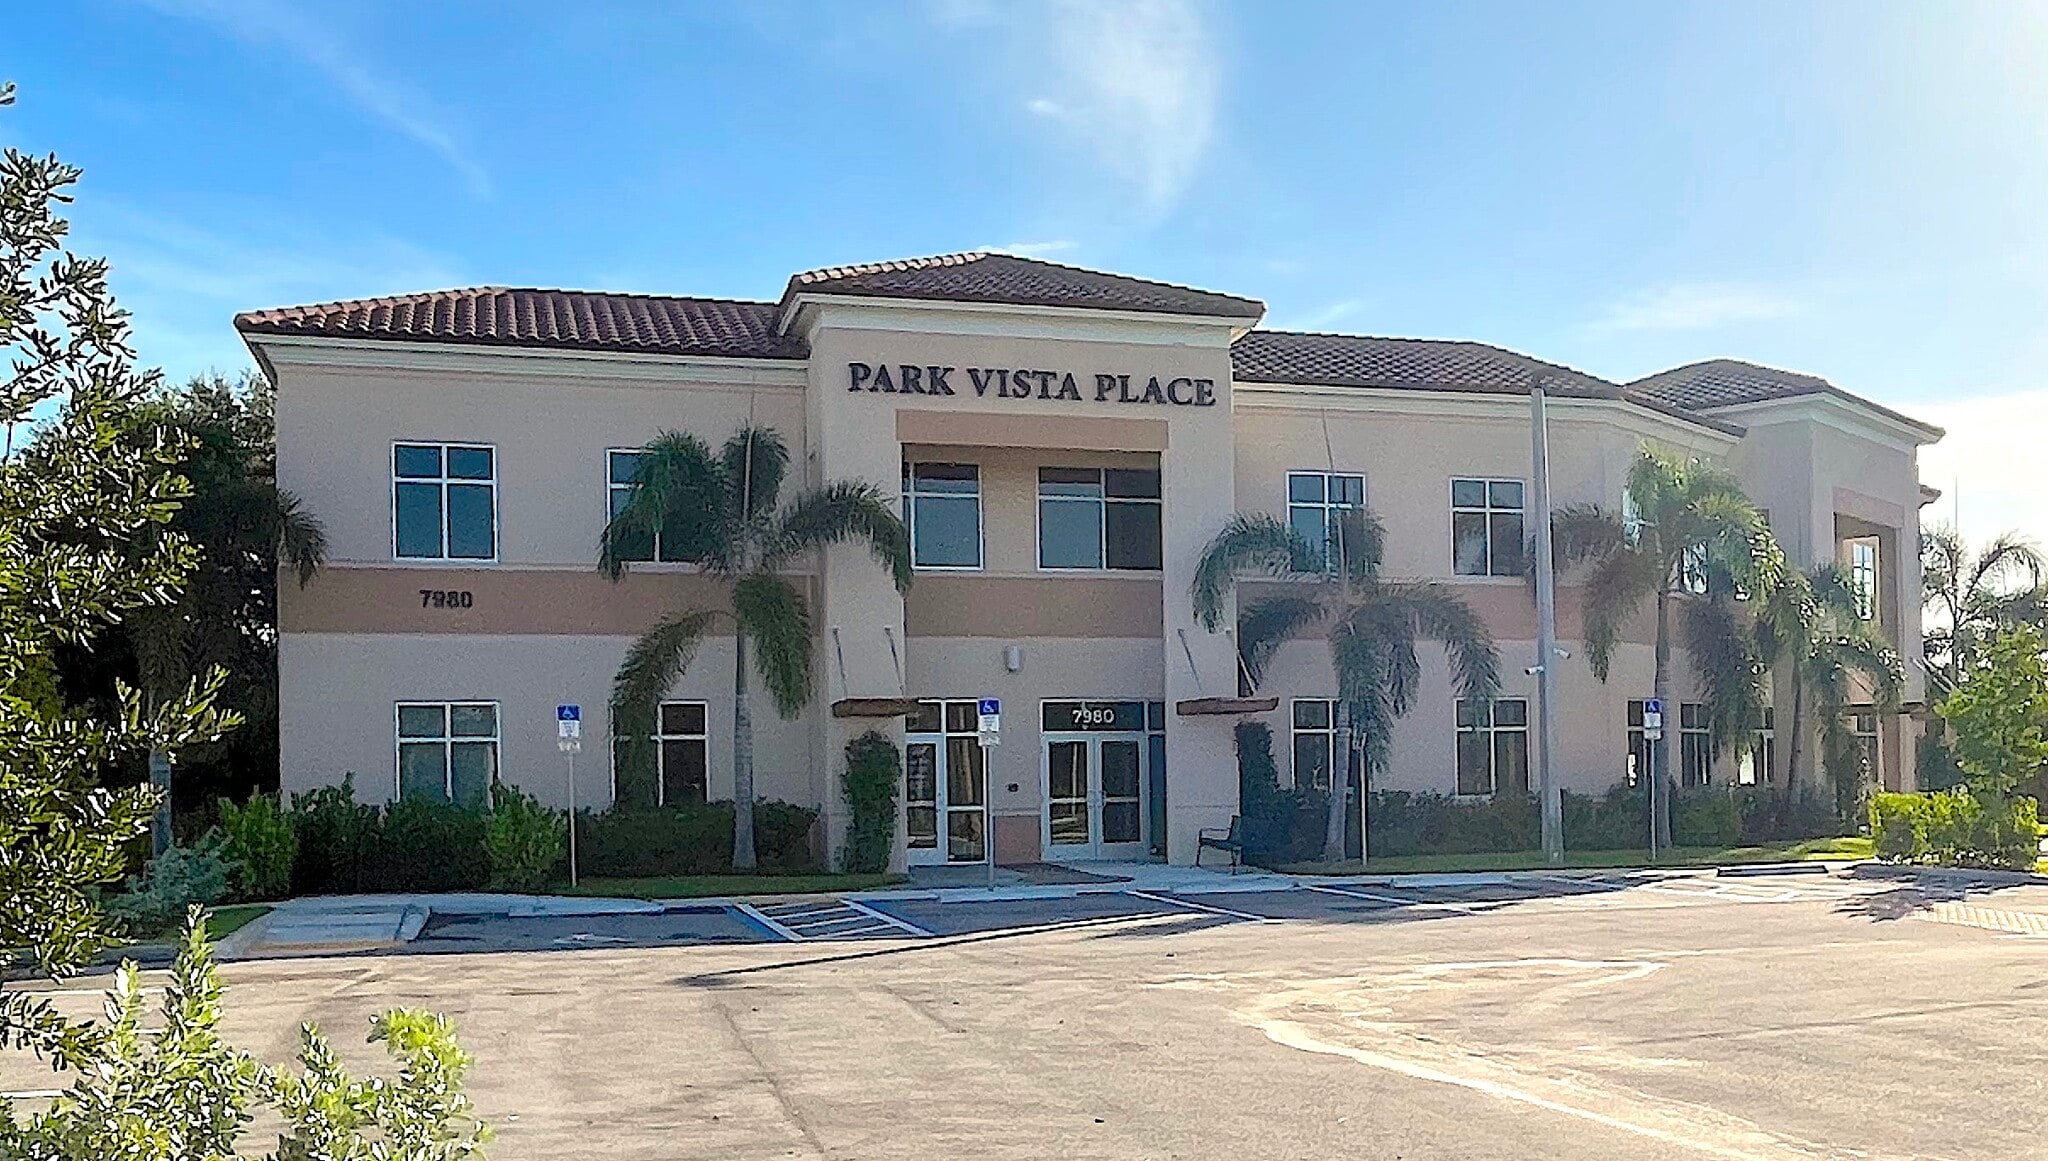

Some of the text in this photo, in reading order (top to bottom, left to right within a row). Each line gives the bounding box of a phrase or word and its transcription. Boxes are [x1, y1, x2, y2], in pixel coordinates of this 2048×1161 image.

[848, 362, 1217, 406] PARK VISTA PLACE
[419, 589, 473, 608] 7980
[1072, 709, 1115, 723] 7980
